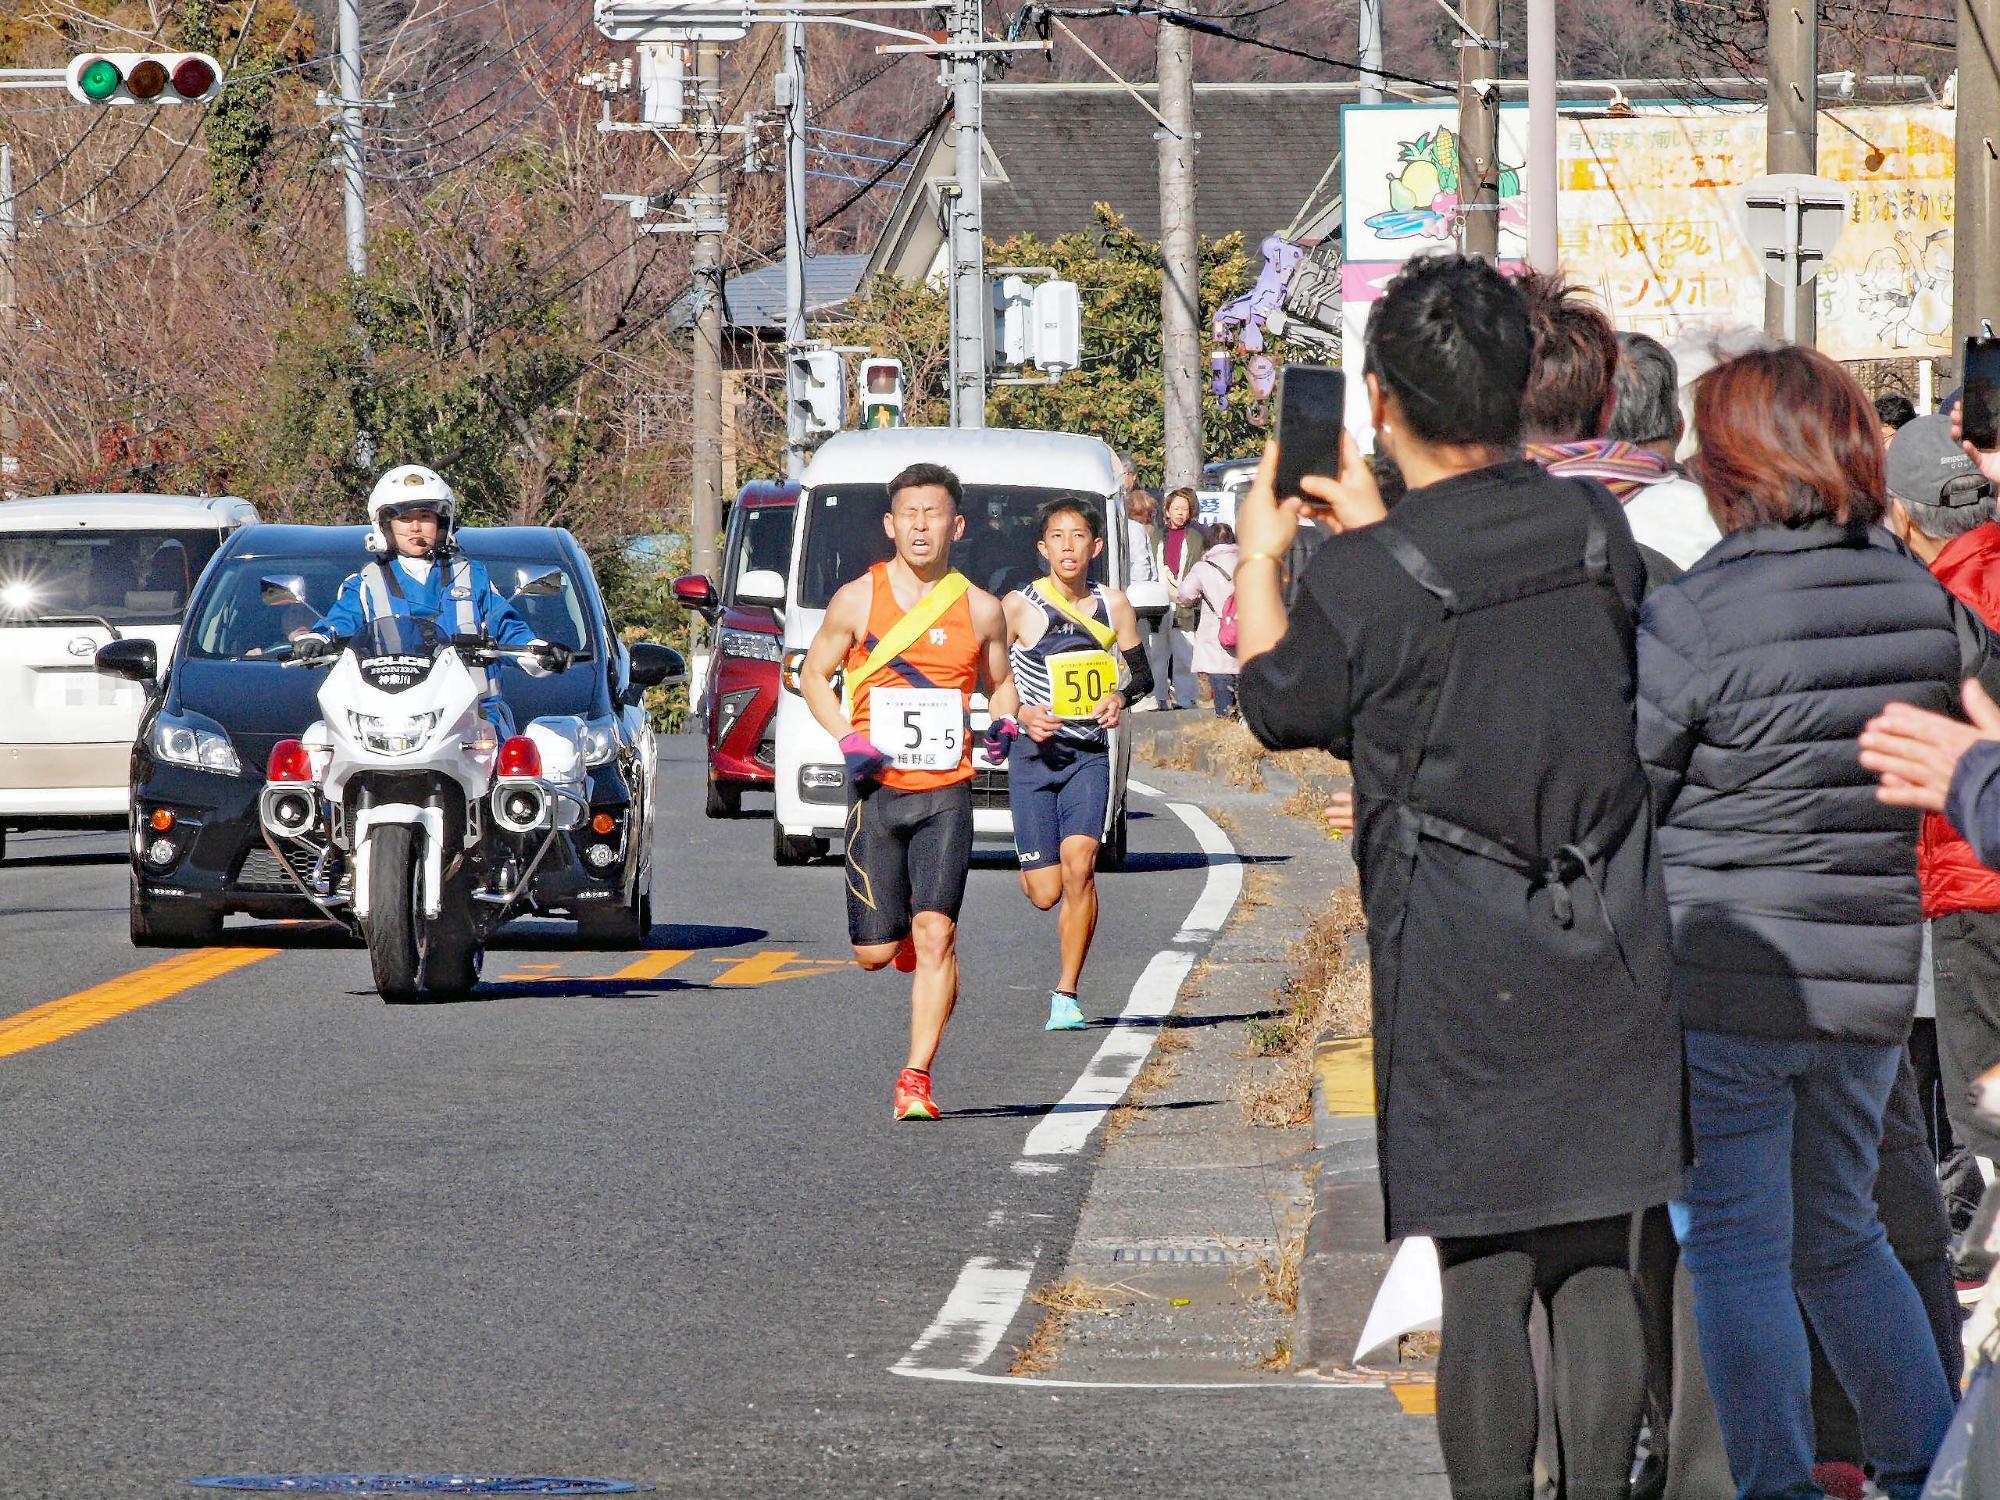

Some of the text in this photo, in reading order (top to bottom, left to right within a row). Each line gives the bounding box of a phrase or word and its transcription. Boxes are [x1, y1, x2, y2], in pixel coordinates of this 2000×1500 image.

[361, 655, 431, 669] POLICE
[370, 666, 421, 675] HONDA
[377, 674, 411, 685] 神奈川
